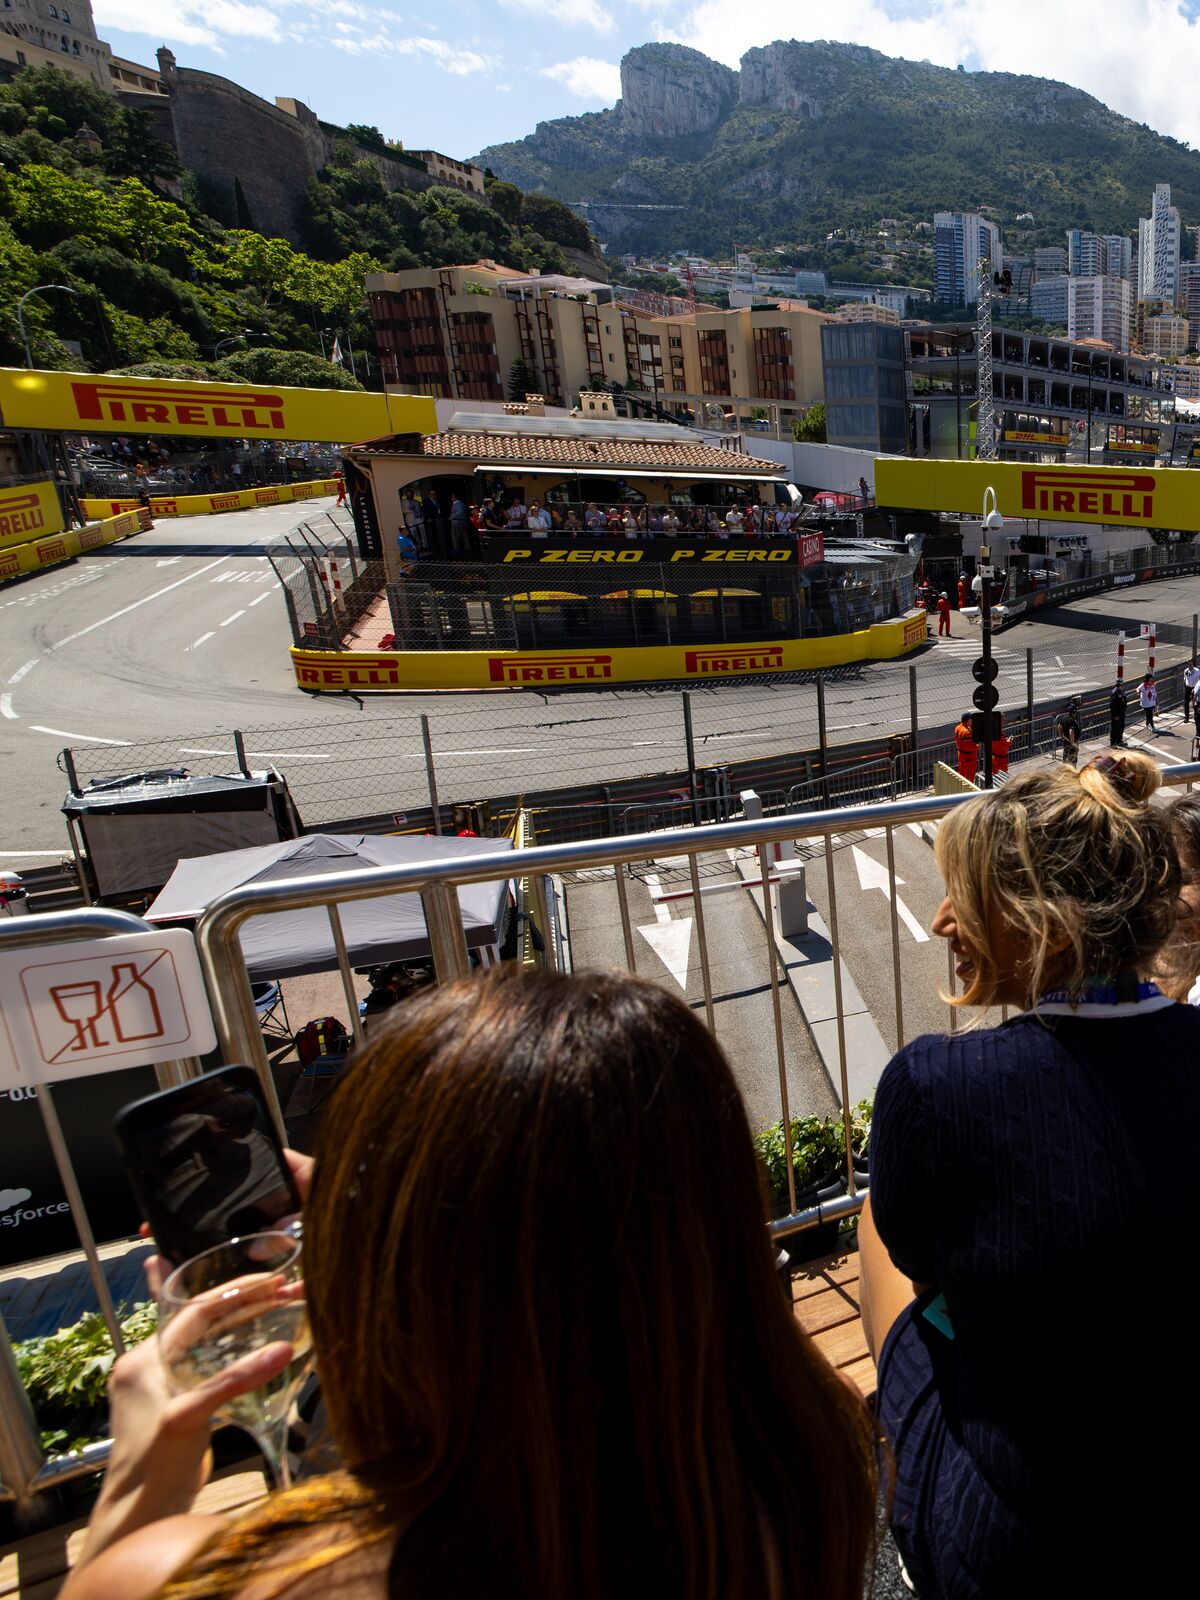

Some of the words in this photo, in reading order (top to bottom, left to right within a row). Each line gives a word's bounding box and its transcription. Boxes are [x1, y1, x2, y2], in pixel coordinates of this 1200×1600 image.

[71, 382, 285, 429] PIRELLI
[210, 495, 240, 510] PIRELLI
[255, 490, 279, 503] PIRELLI
[1022, 471, 1156, 518] PIRELLI
[0, 493, 44, 536] RELLI
[36, 539, 66, 564] PIRELLI
[503, 550, 532, 562] P
[539, 550, 644, 562] ZERO
[670, 550, 695, 562] P
[701, 550, 792, 562] ZERO
[488, 656, 612, 682] PIRELLI
[685, 646, 784, 673] PIRELLI
[0, 1202, 70, 1227] sforce
